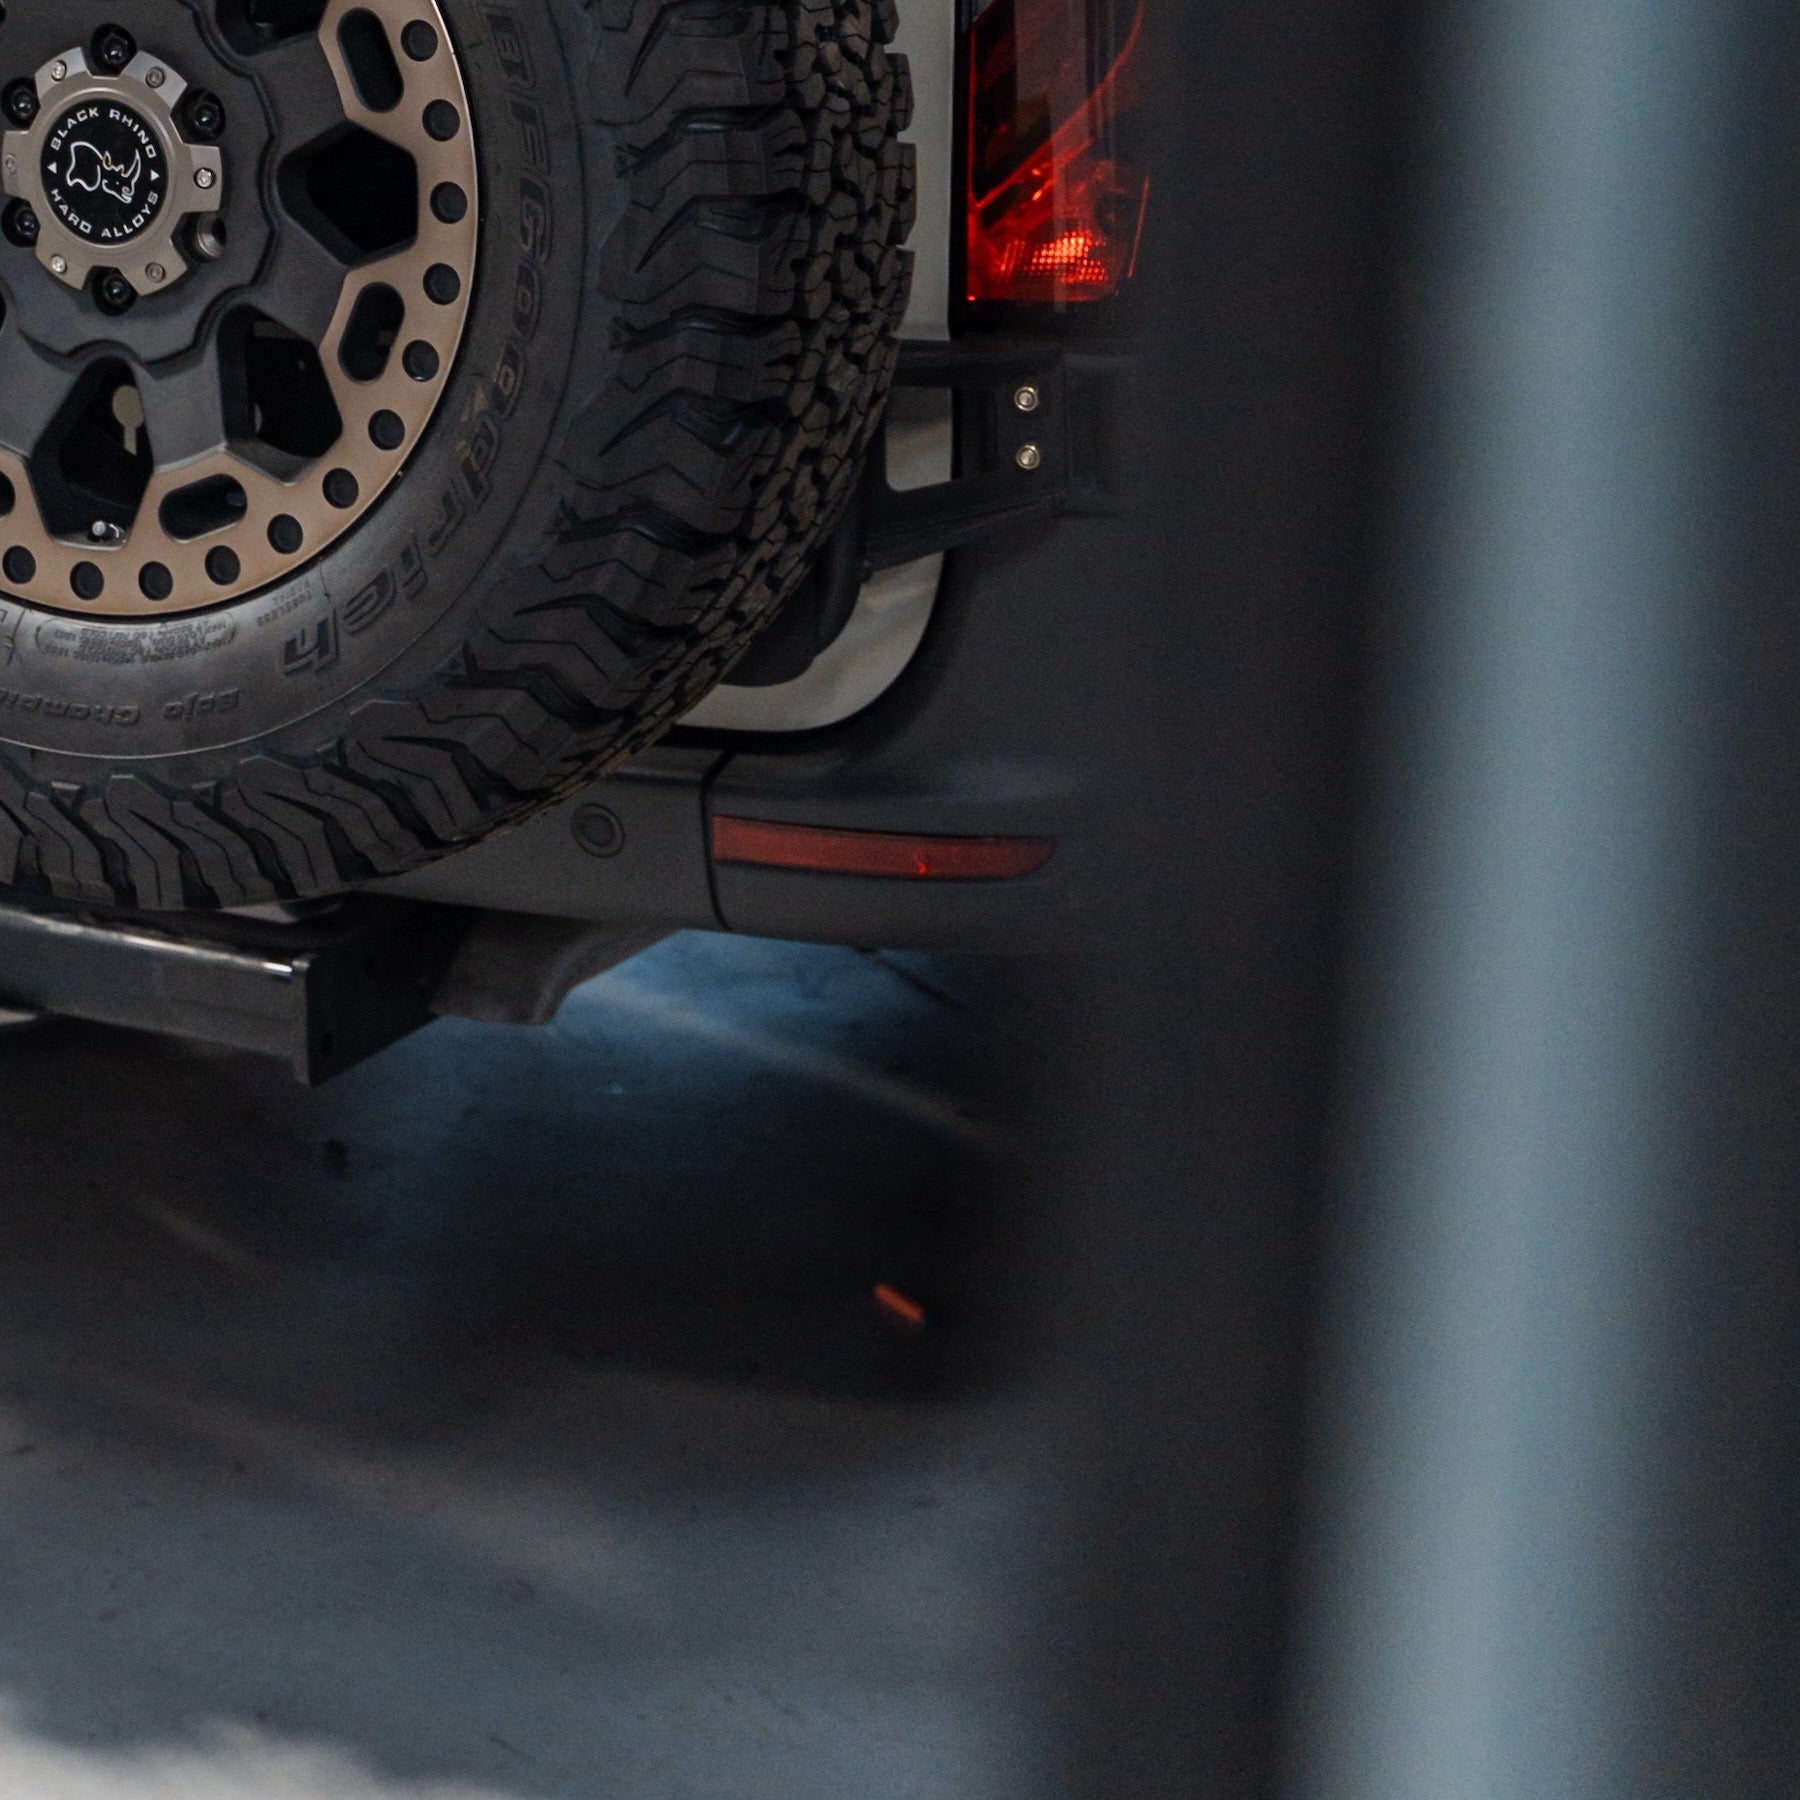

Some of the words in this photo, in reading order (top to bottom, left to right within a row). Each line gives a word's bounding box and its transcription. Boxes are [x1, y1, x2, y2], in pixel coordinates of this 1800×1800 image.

[50, 107, 99, 151] BLACK
[109, 108, 157, 159] RHINO
[51, 188, 92, 234] HARD
[101, 191, 159, 238] ALLOYS
[280, 5, 553, 677] BFGoodrich
[162, 688, 240, 721] Baja
